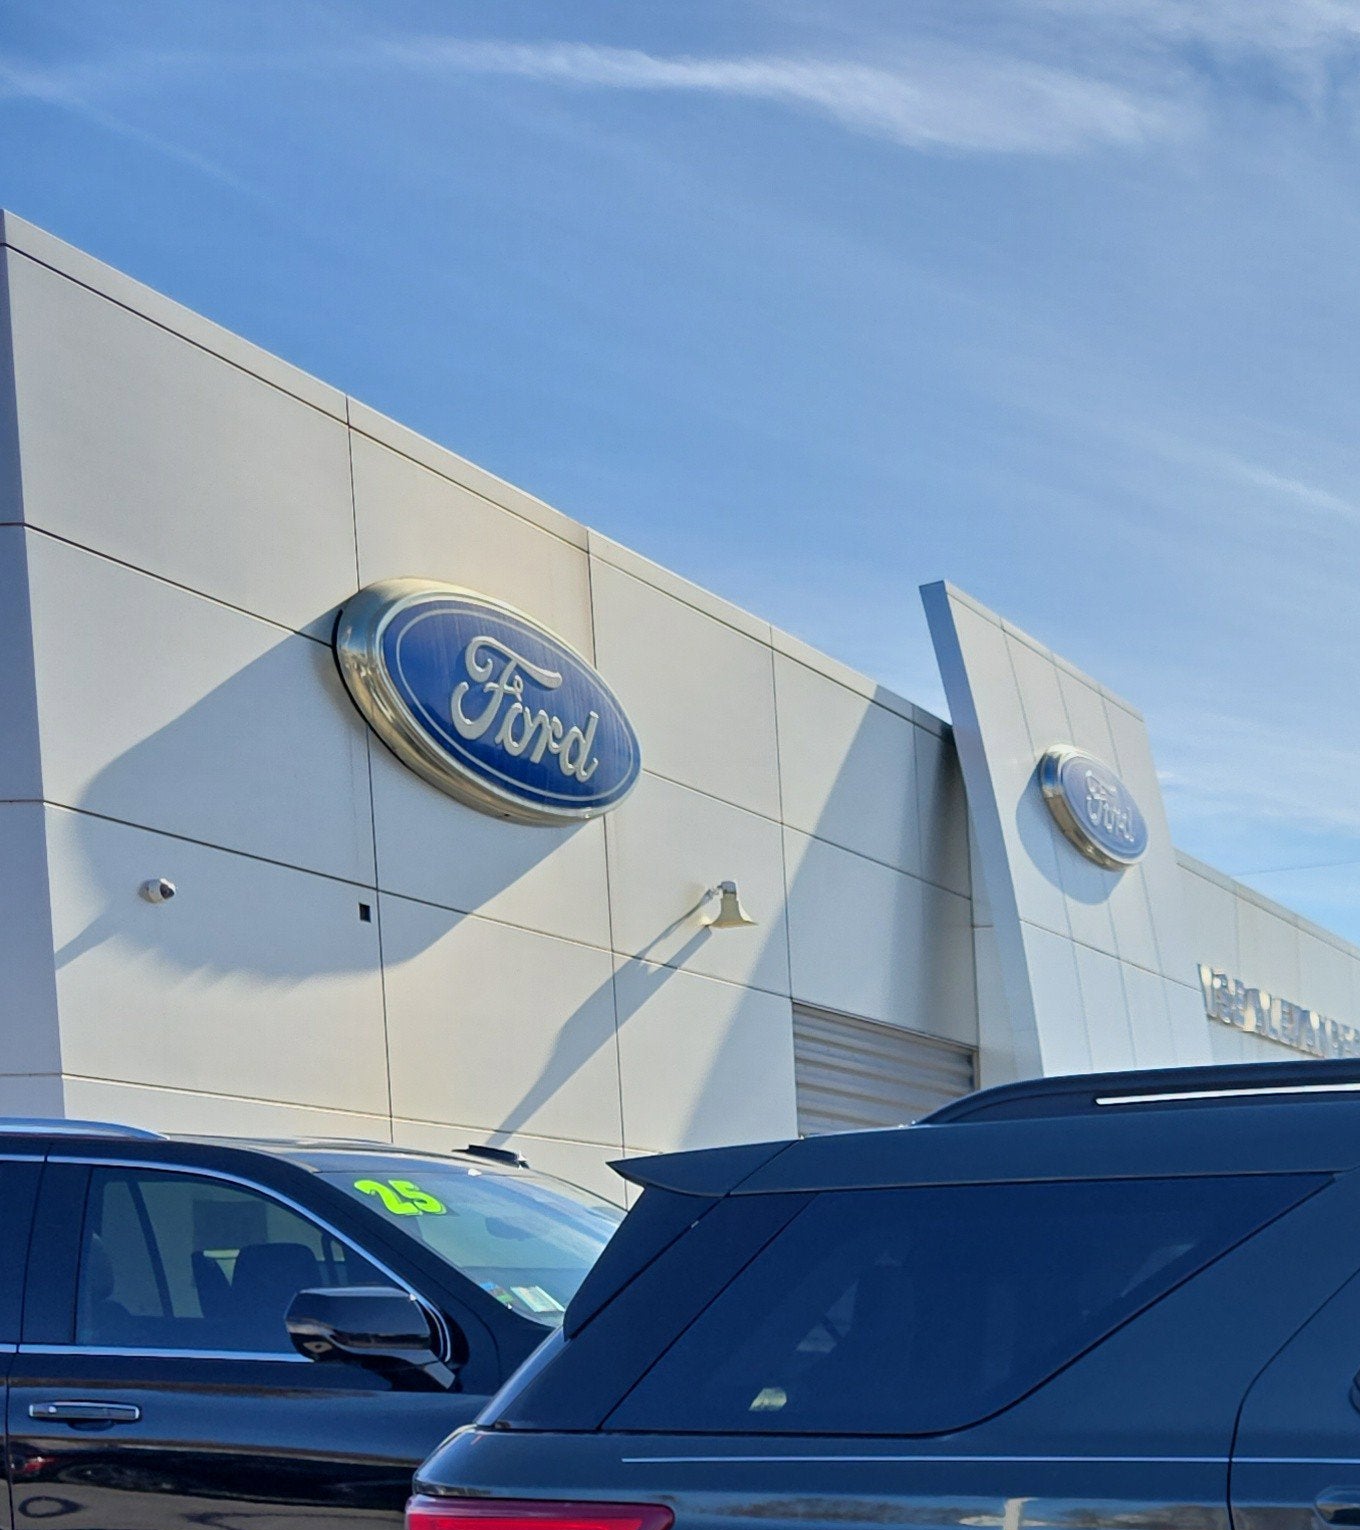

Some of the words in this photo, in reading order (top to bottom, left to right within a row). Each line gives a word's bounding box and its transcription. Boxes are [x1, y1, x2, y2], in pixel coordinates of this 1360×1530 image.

[451, 635, 599, 783] Ford
[1085, 769, 1135, 843] Ford
[354, 1179, 447, 1216] 25
